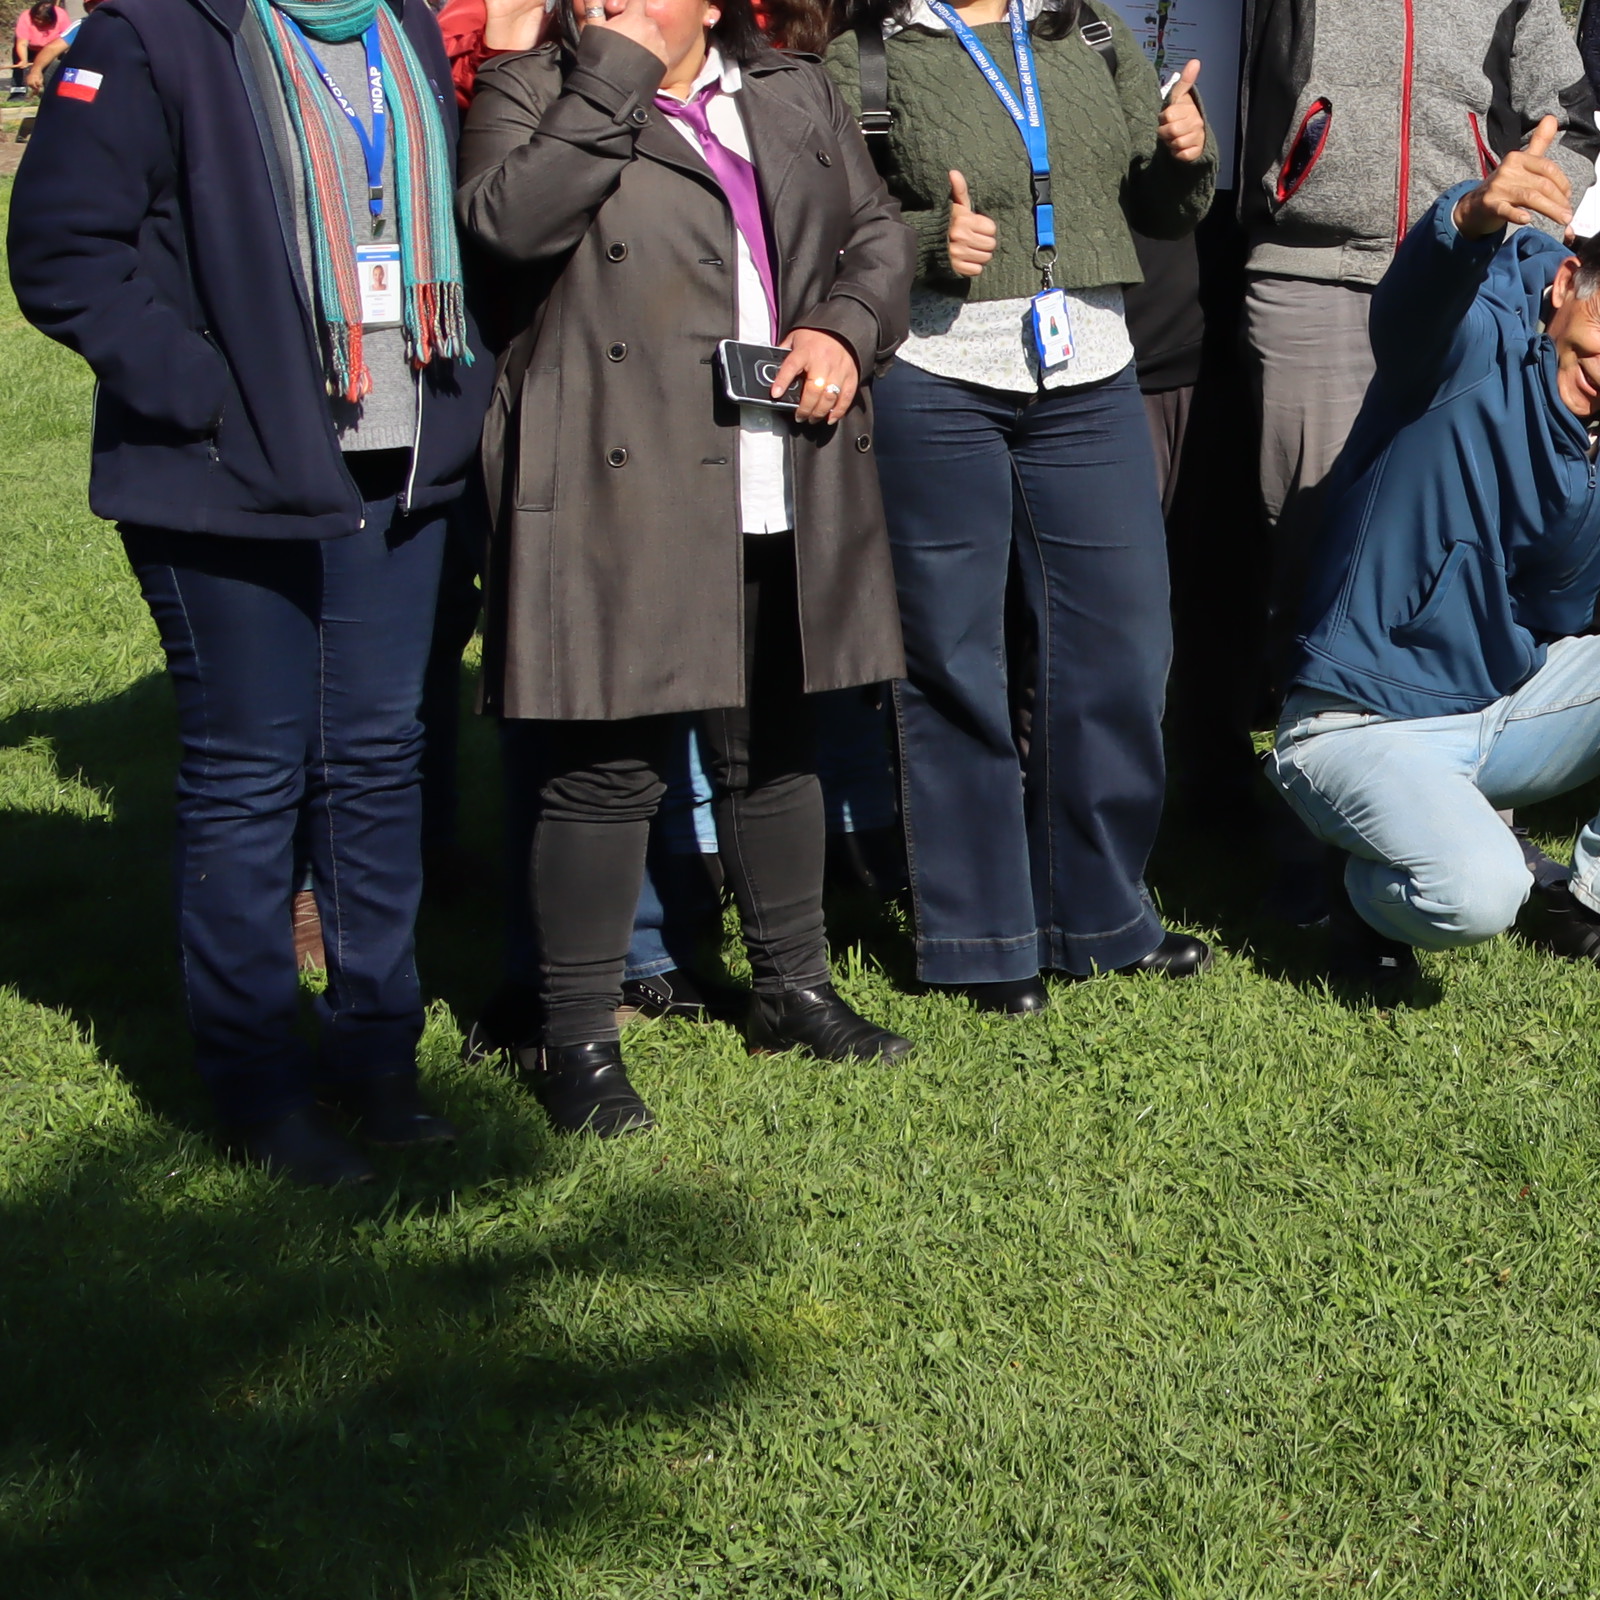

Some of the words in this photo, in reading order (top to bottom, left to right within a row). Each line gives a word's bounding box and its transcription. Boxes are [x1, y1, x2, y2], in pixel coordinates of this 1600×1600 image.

[966, 41, 990, 70] Interior
[986, 68, 999, 82] del
[322, 73, 355, 117] INDAP
[370, 66, 384, 114] INDAP
[1021, 72, 1032, 85] del
[995, 81, 1025, 120] Ministerio
[1025, 86, 1040, 127] Ministerio
